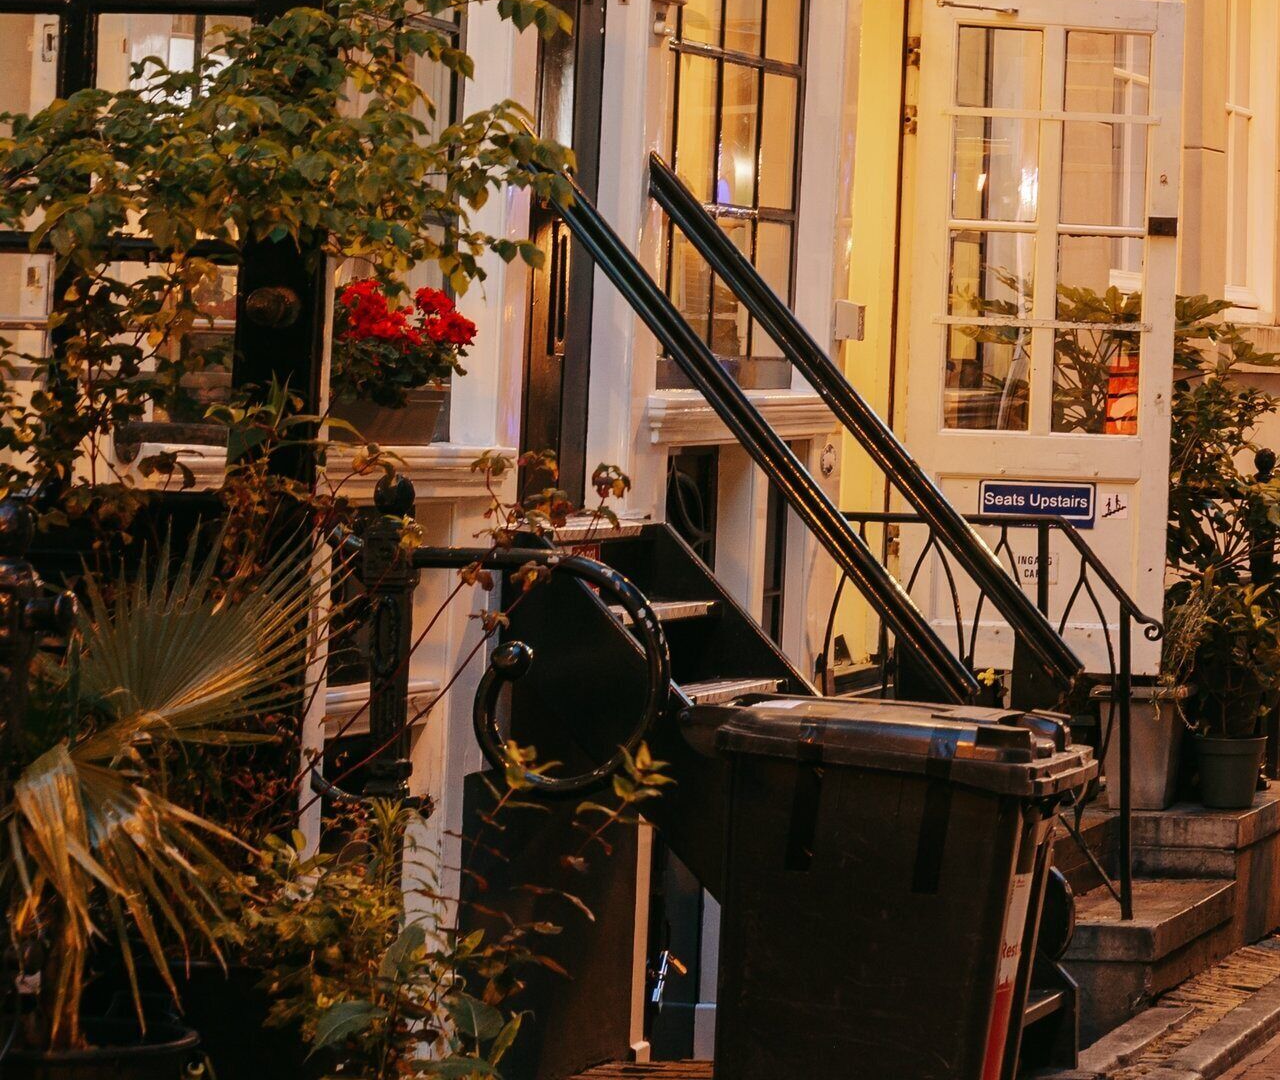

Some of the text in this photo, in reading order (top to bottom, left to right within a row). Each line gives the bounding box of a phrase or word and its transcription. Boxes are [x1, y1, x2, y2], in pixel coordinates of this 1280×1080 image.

[984, 491, 1088, 509] Seats Upstairs
[1017, 555, 1053, 566] INGG
